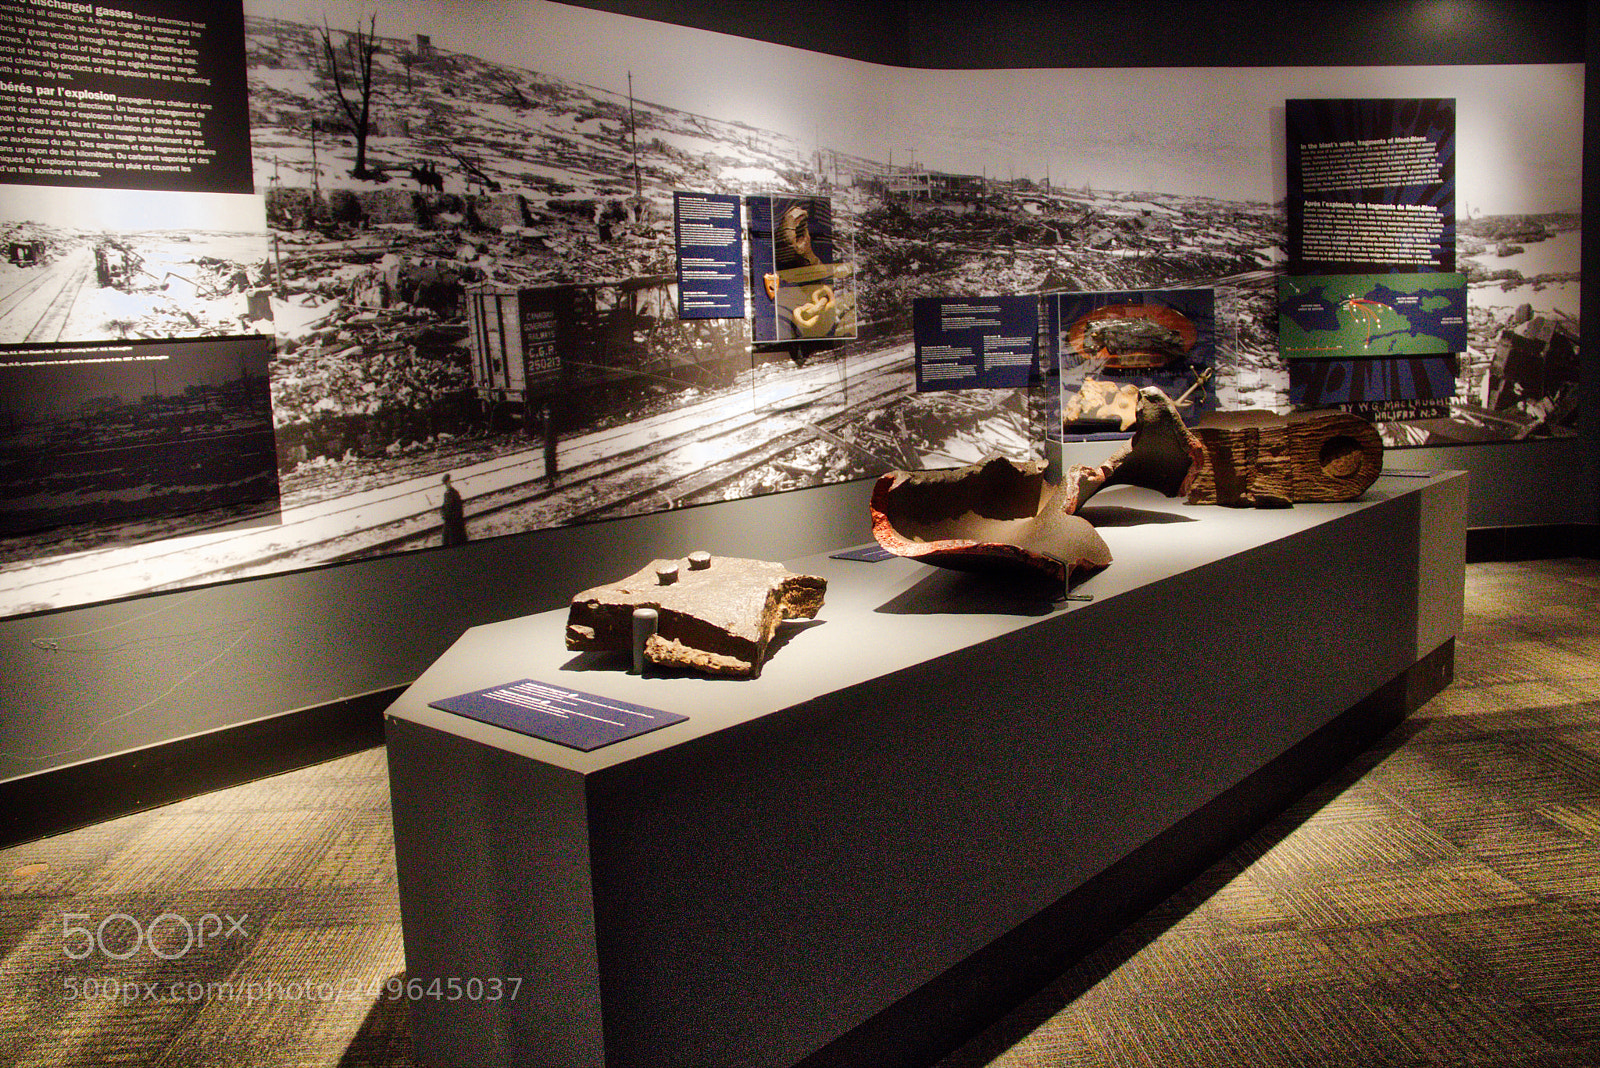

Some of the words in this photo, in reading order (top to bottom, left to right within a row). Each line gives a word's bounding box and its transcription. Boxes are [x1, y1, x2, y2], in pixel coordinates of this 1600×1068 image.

[95, 7, 133, 19] gasses
[15, 16, 35, 25] blast
[77, 26, 100, 34] shock
[47, 11, 87, 22] directions.
[95, 18, 116, 27] sharp
[117, 21, 142, 31] change
[28, 29, 49, 37] great
[50, 33, 78, 42] velocity
[79, 36, 107, 45] through
[121, 41, 149, 49] districts
[33, 40, 57, 50] rolling
[58, 43, 79, 51] cloud
[89, 46, 101, 54] hot
[134, 52, 149, 60] high
[42, 51, 59, 59] ship
[60, 53, 90, 62] dropped
[14, 58, 50, 67] chemical
[51, 62, 92, 72] by-products
[116, 70, 149, 78] explosion
[22, 68, 42, 77] dark,
[43, 71, 56, 79] oily
[57, 72, 74, 80] film.
[0, 81, 33, 93] bérés
[36, 87, 55, 96] par
[57, 87, 117, 101] l'explosion
[17, 96, 38, 104] dans
[77, 102, 115, 111] directions.
[127, 106, 155, 114] brusque
[155, 109, 196, 117] changement
[71, 111, 112, 120] d'explosion
[16, 116, 44, 124] vitesse
[45, 118, 62, 126] l'air,
[91, 122, 142, 132] l'accumulation
[27, 127, 55, 135] d'autre
[70, 130, 103, 138] Narrows.
[10, 137, 49, 145] au-dessus
[1357, 139, 1386, 147] fragments
[37, 158, 77, 166] l'explosion
